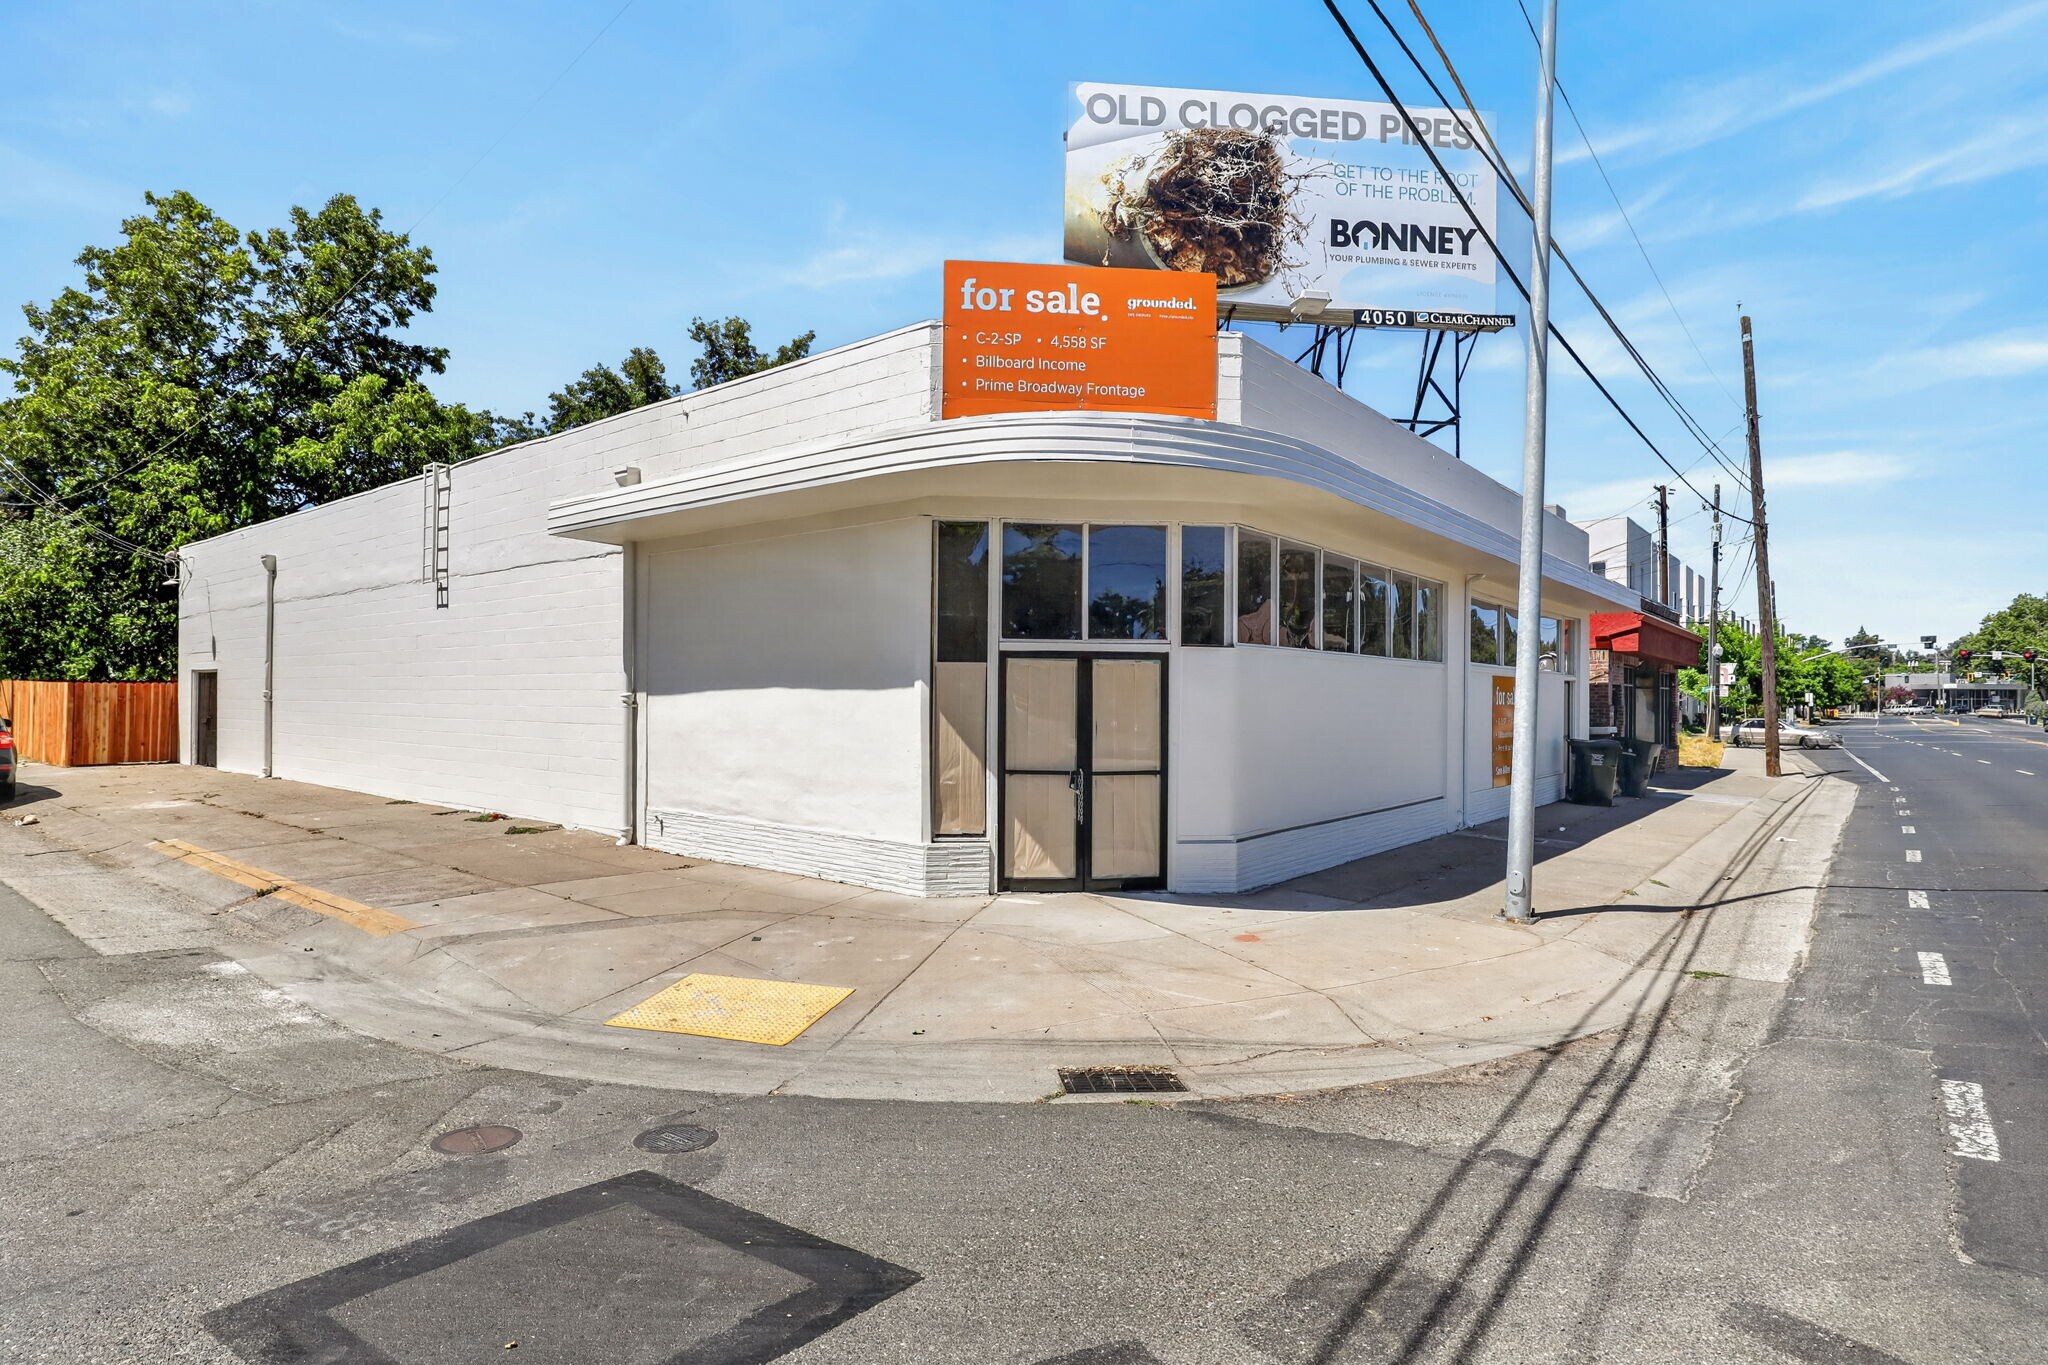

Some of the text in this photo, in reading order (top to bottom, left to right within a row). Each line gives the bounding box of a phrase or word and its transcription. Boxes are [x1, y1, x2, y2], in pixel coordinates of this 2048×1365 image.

[1086, 92, 1167, 127] OLD
[1178, 99, 1367, 141] CLOGGED
[1334, 163, 1367, 180] GET
[1371, 166, 1393, 181] TO
[1397, 168, 1429, 184] THE
[1335, 181, 1358, 196] OF
[1362, 183, 1394, 199] THE
[1330, 218, 1478, 256] BONNEY
[1329, 253, 1478, 271] YOUR PLUMBING & SEWER EXPERTS
[960, 277, 1109, 322] for sale.
[1127, 296, 1197, 310] grounded.
[1360, 310, 1407, 325] 4050
[975, 331, 1022, 345] C-2-SP
[1050, 335, 1107, 349] 4,558 SF
[975, 354, 1087, 371] Billboard Income
[975, 378, 1146, 399] Prime Broadway Frontage
[1496, 686, 1505, 705] for
